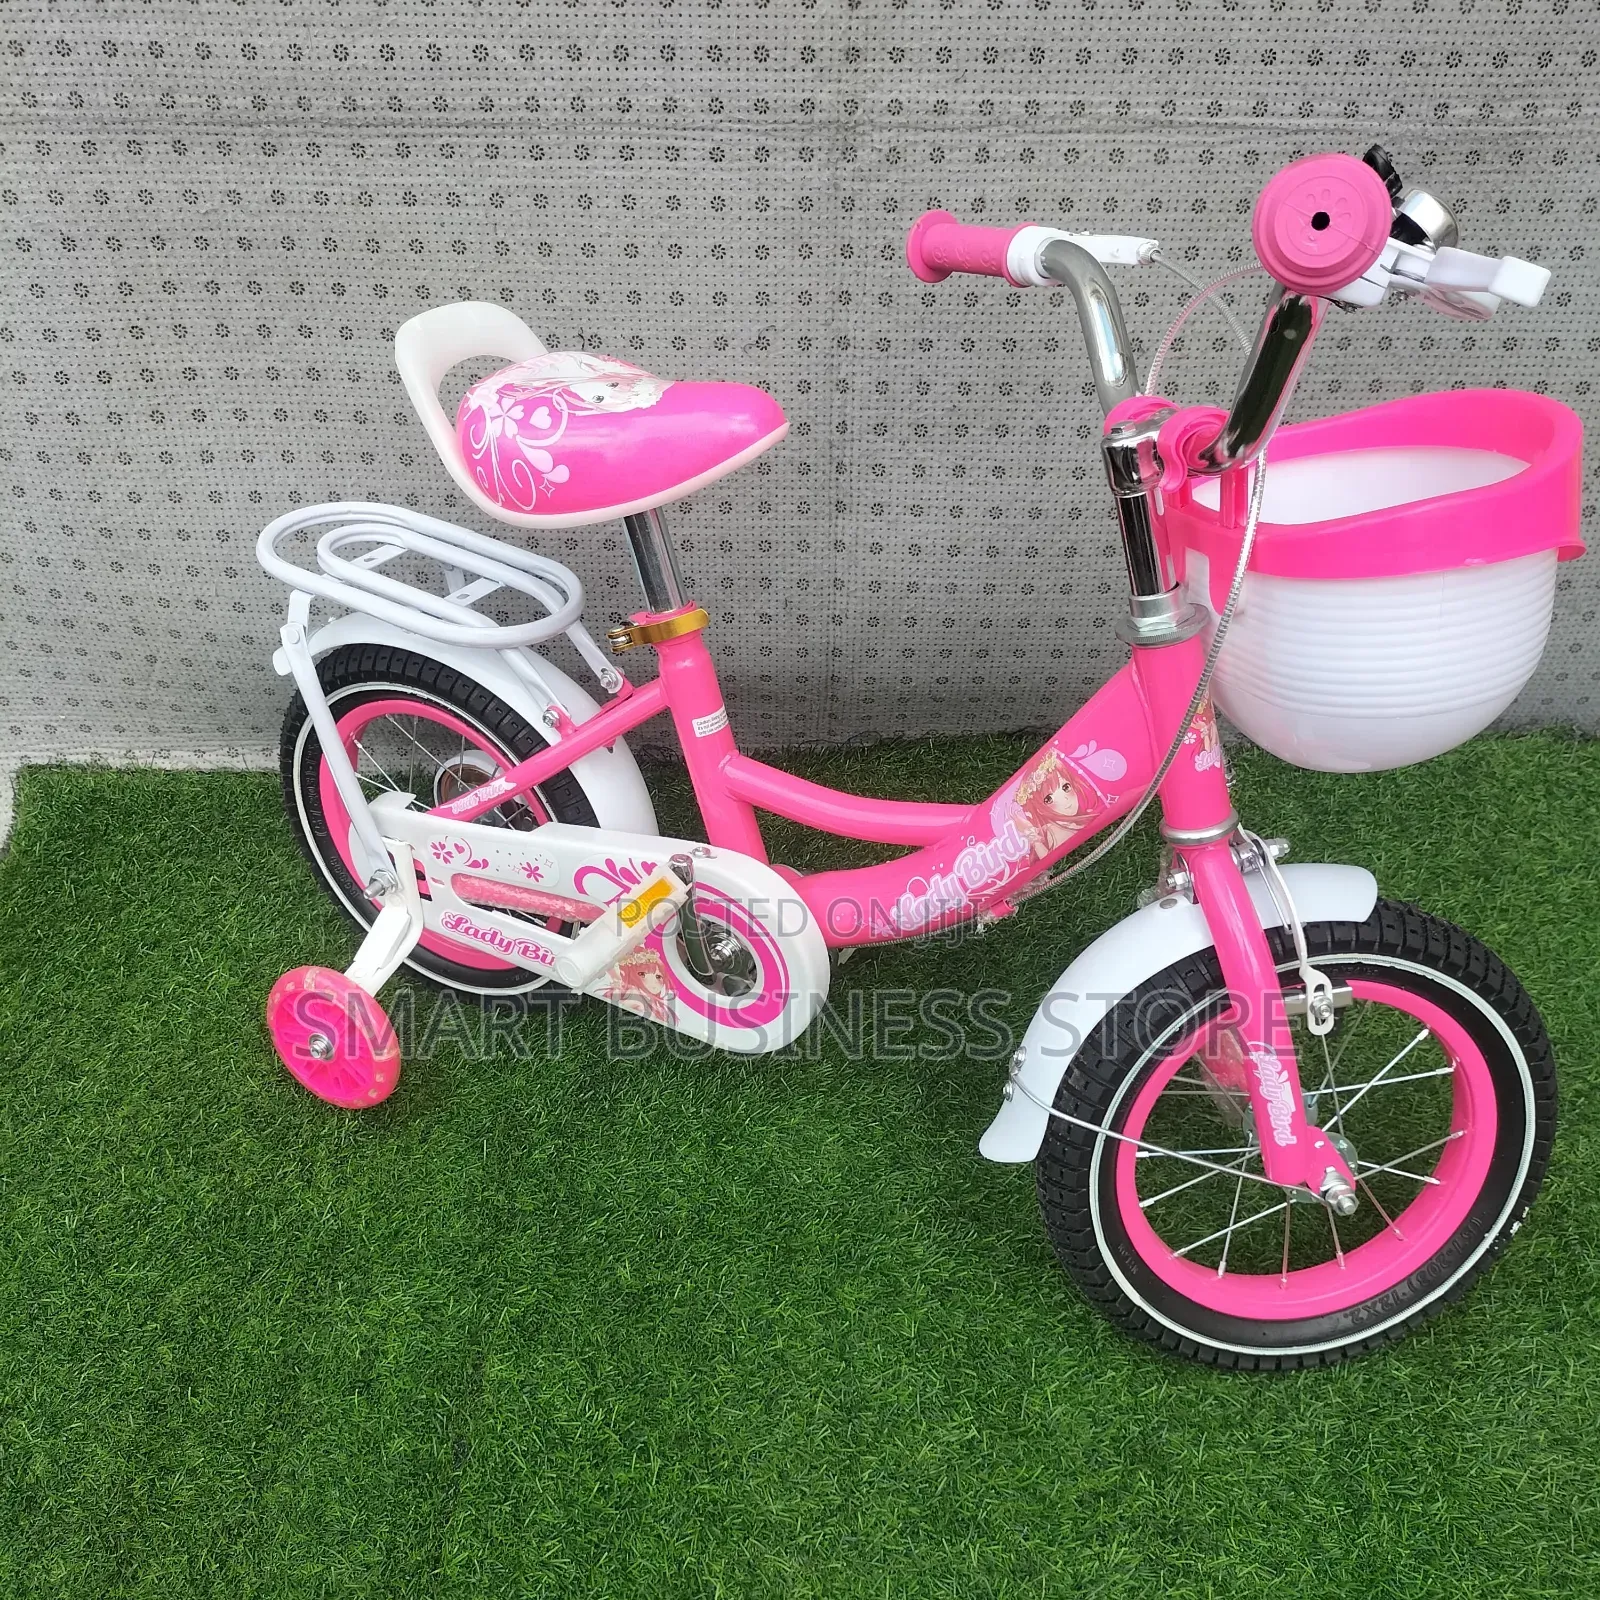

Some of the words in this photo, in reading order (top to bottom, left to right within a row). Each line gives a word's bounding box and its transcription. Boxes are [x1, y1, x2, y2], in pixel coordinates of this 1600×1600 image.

[891, 873, 967, 930] Lady
[954, 821, 1030, 888] Bird
[442, 912, 515, 954] Lady
[1249, 1051, 1283, 1104] Lady
[1267, 1100, 1297, 1146] Bird
